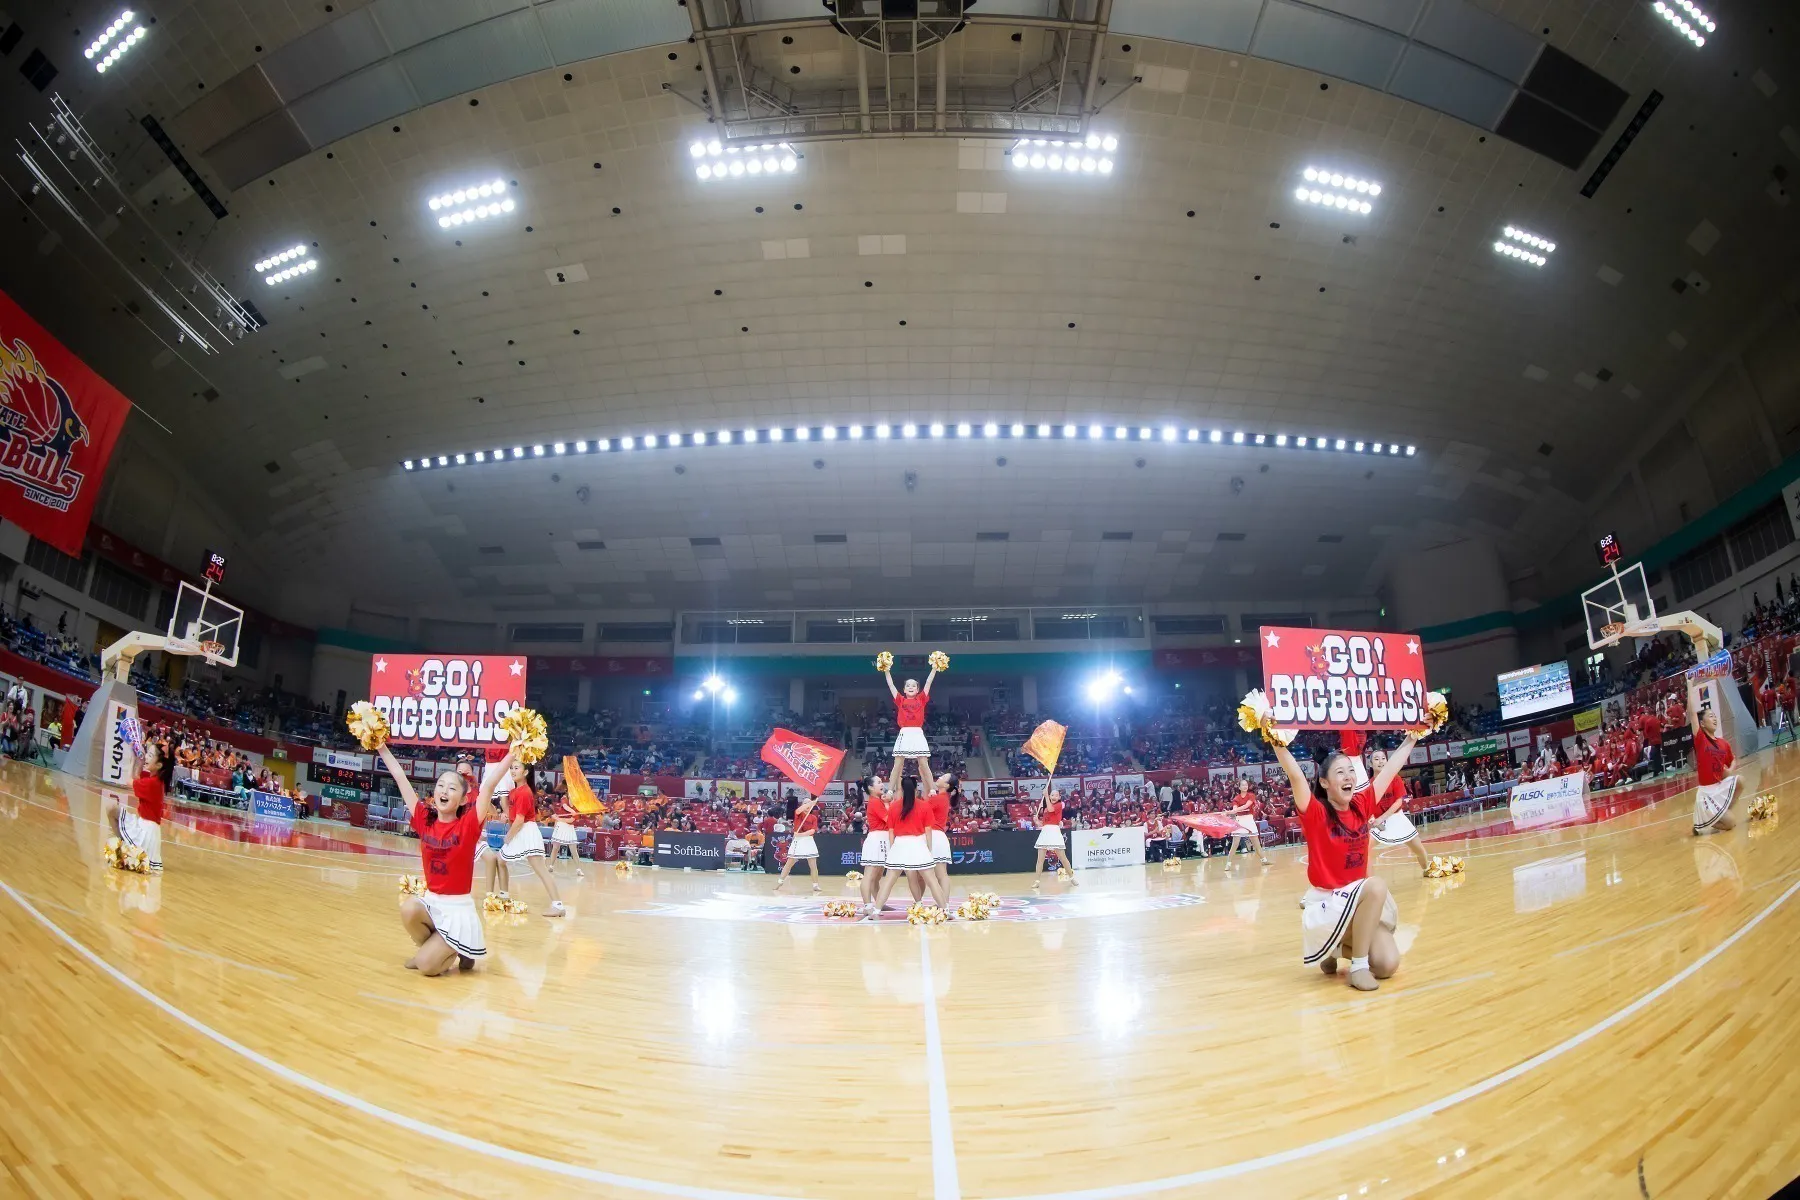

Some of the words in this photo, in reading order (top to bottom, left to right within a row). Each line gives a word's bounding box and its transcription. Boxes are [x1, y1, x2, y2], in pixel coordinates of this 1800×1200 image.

[0, 406, 27, 428] ATE
[25, 488, 49, 505] SINCE
[50, 498, 69, 511] 2011
[1603, 542, 1620, 563] 24
[206, 562, 224, 581] 24
[1321, 634, 1386, 677] GO!
[420, 659, 483, 698] GO!
[1270, 673, 1426, 724] BIGBULLS!
[373, 694, 521, 745] BIGBULLS
[1475, 755, 1491, 765] 822
[321, 775, 331, 783] 43
[337, 769, 354, 779] 8:22
[360, 782, 370, 790] 45
[1519, 789, 1545, 802] ALSOK
[673, 844, 720, 858] SoftBank
[1087, 847, 1131, 857] INFRONEER
